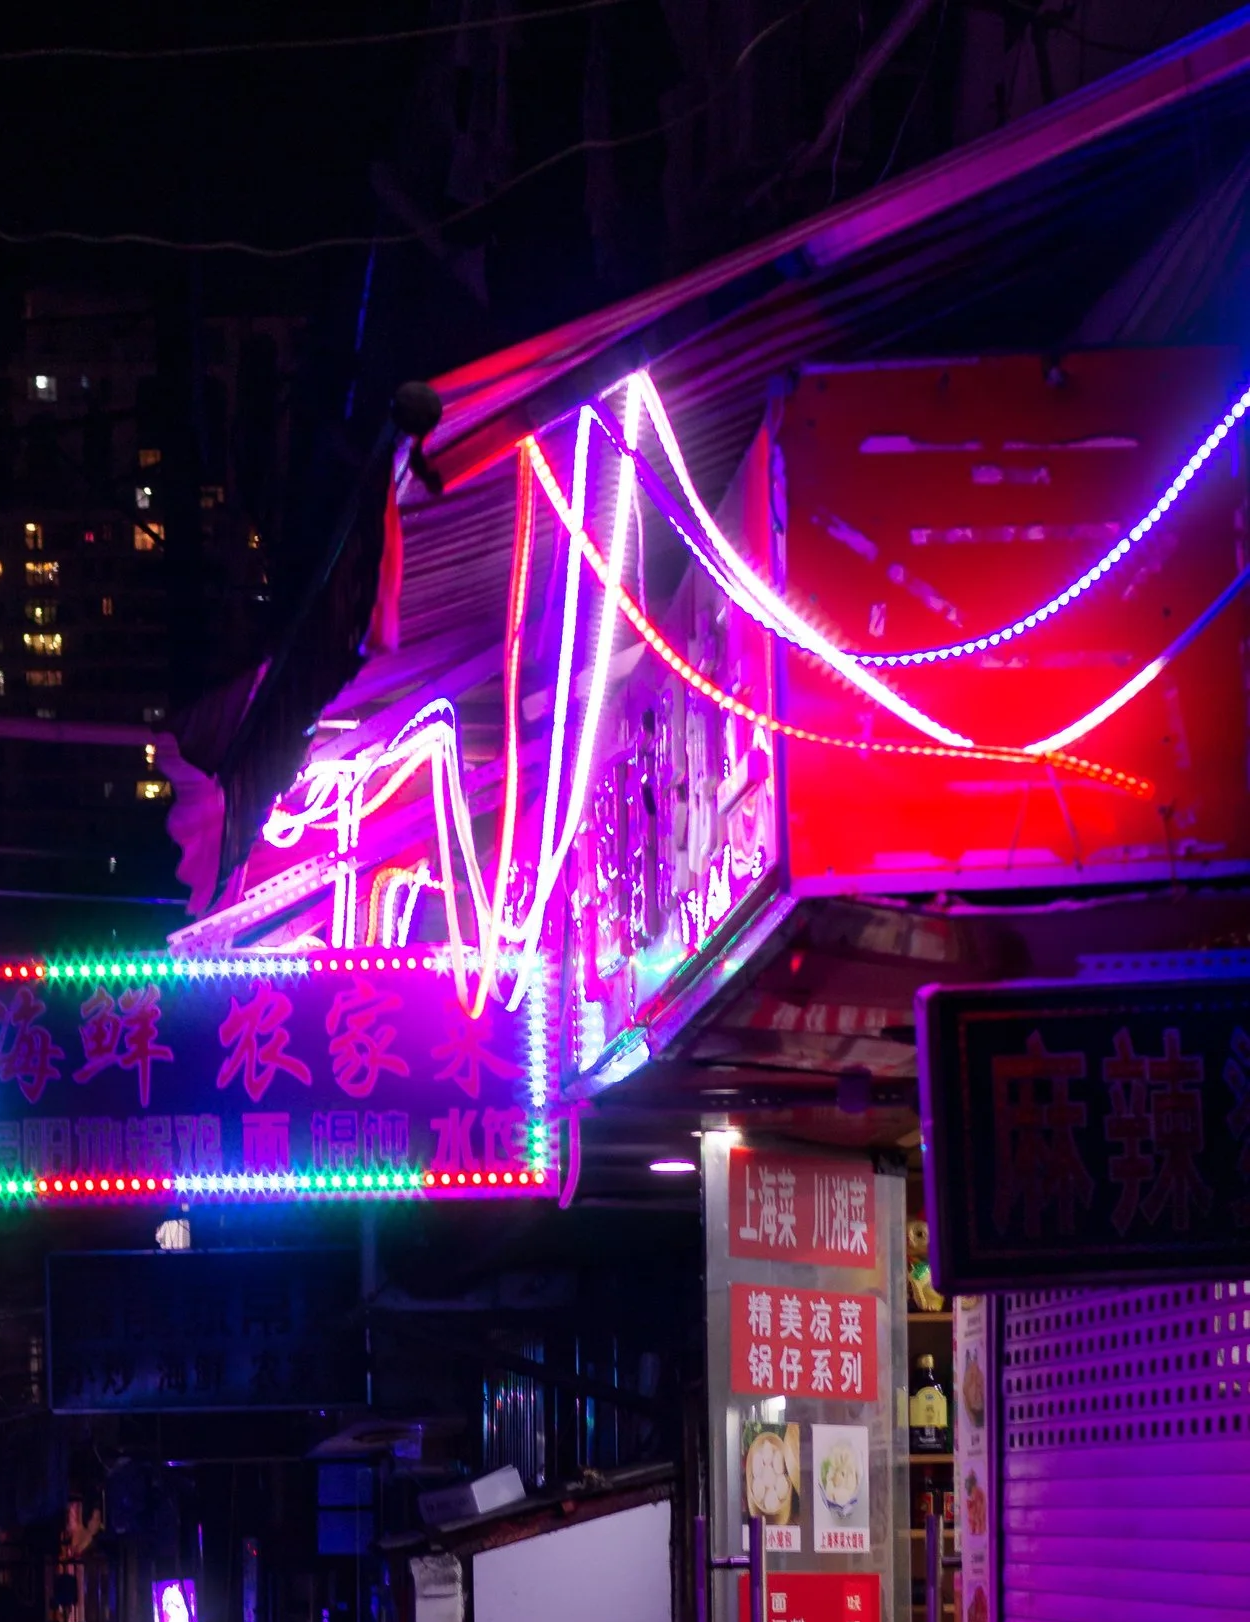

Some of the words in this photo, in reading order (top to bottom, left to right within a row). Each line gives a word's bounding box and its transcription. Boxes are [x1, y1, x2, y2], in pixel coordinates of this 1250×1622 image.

[241, 1112, 290, 1174] 面
[311, 1109, 409, 1173] 馄饨
[990, 1025, 1250, 1238] 麻辣
[739, 1164, 798, 1248] 上海菜
[811, 1172, 869, 1255] 川湘菜
[747, 1290, 863, 1345] 精美凉菜
[747, 1341, 863, 1394] 锅仔系列
